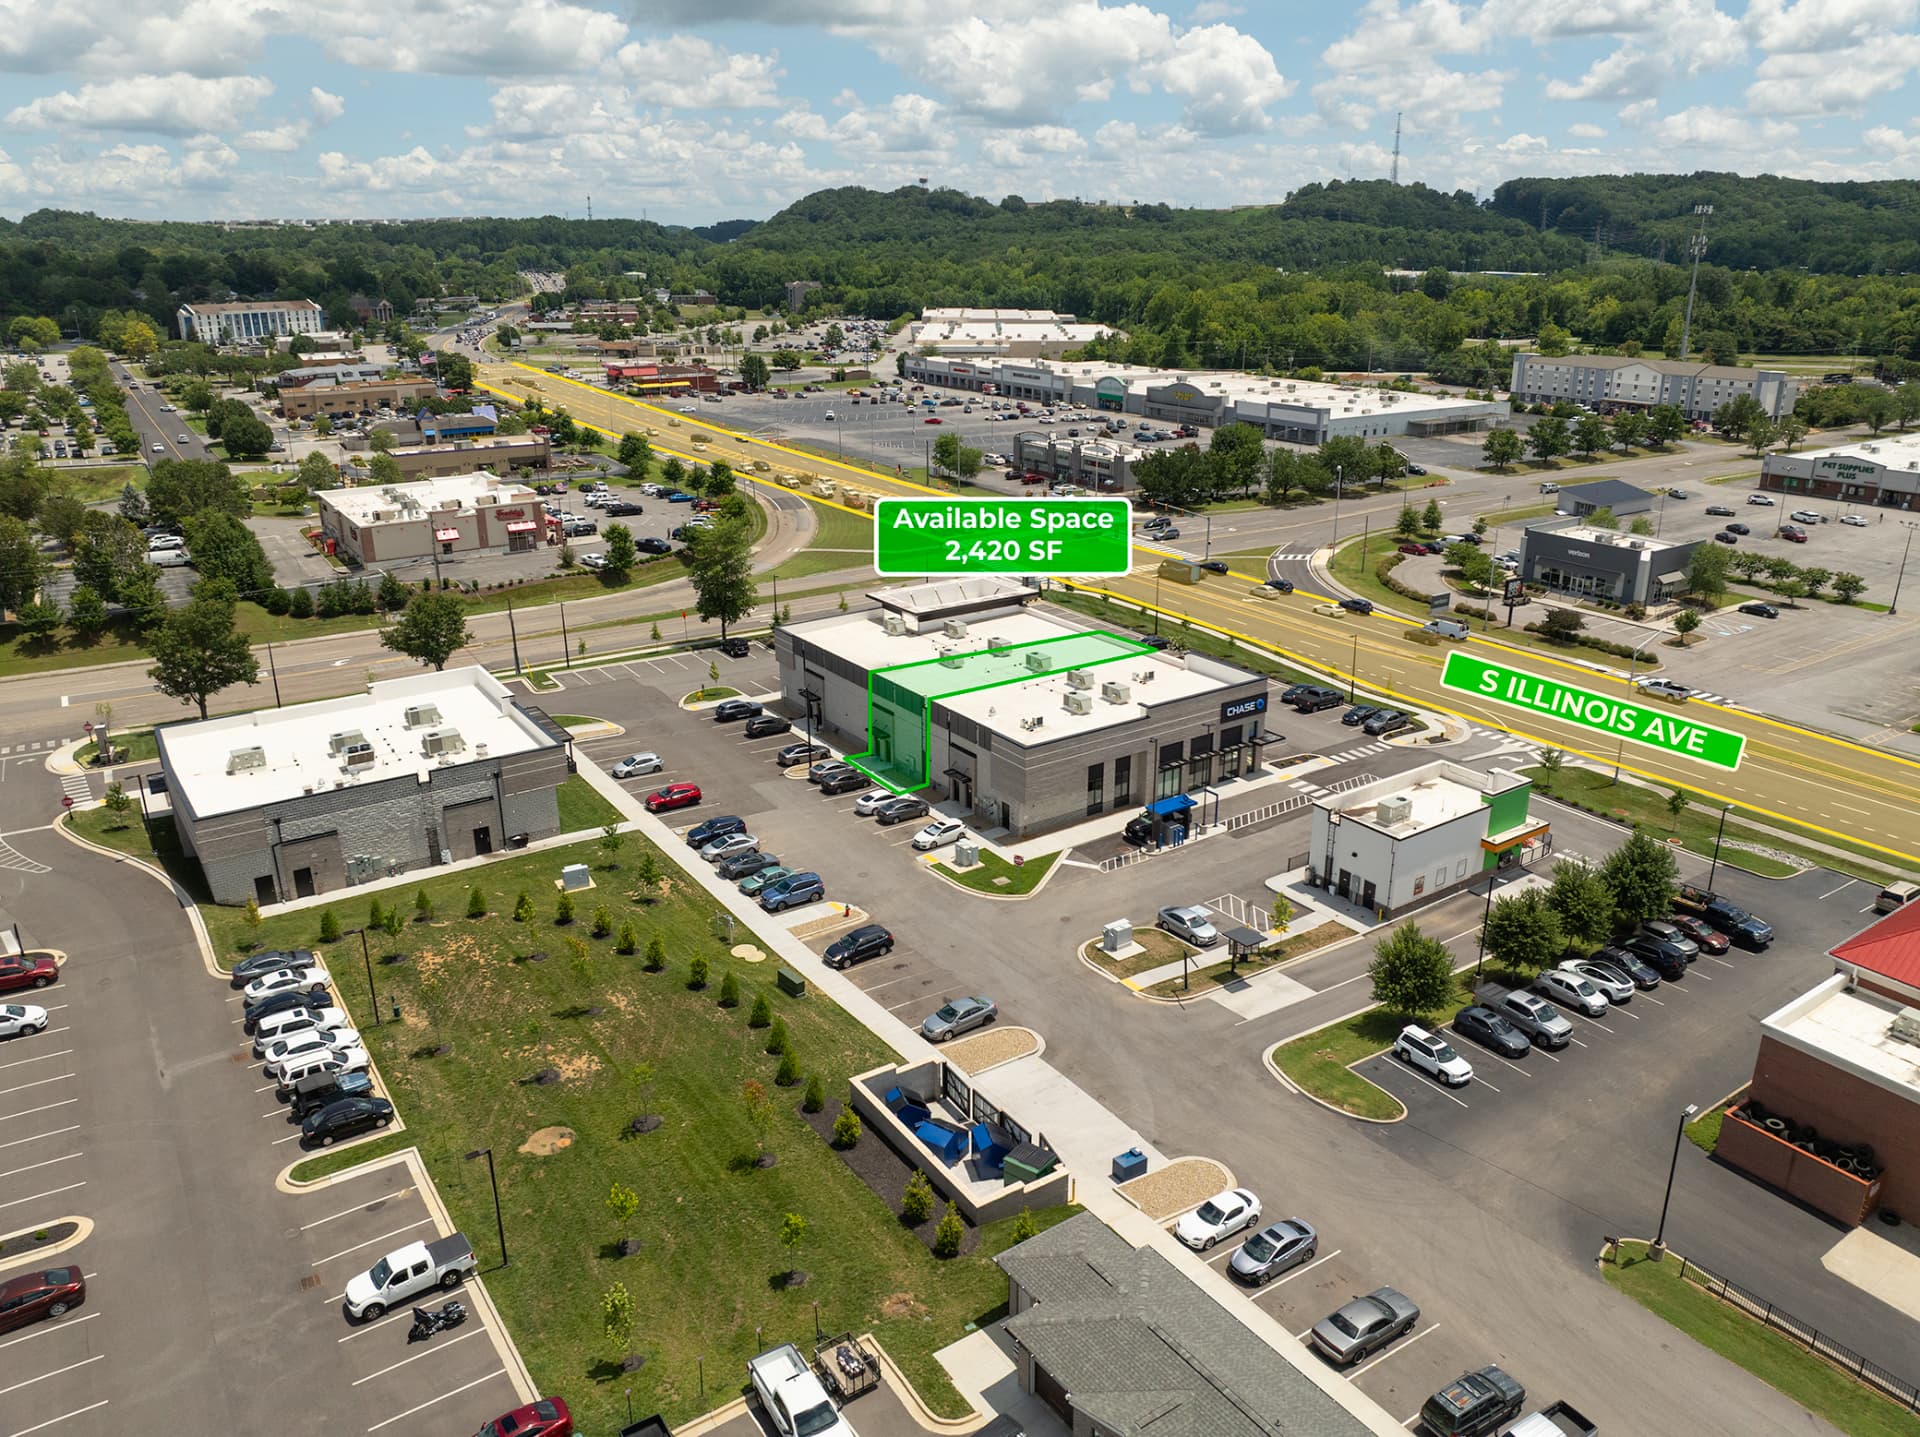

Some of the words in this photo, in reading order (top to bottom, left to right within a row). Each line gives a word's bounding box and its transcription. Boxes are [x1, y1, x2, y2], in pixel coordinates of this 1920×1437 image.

[1822, 461, 1837, 469] PET
[1837, 463, 1875, 474] SUPPLIES
[1836, 471, 1857, 480] PLUS
[1567, 549, 1590, 559] verizon
[1226, 701, 1256, 717] CHASE
